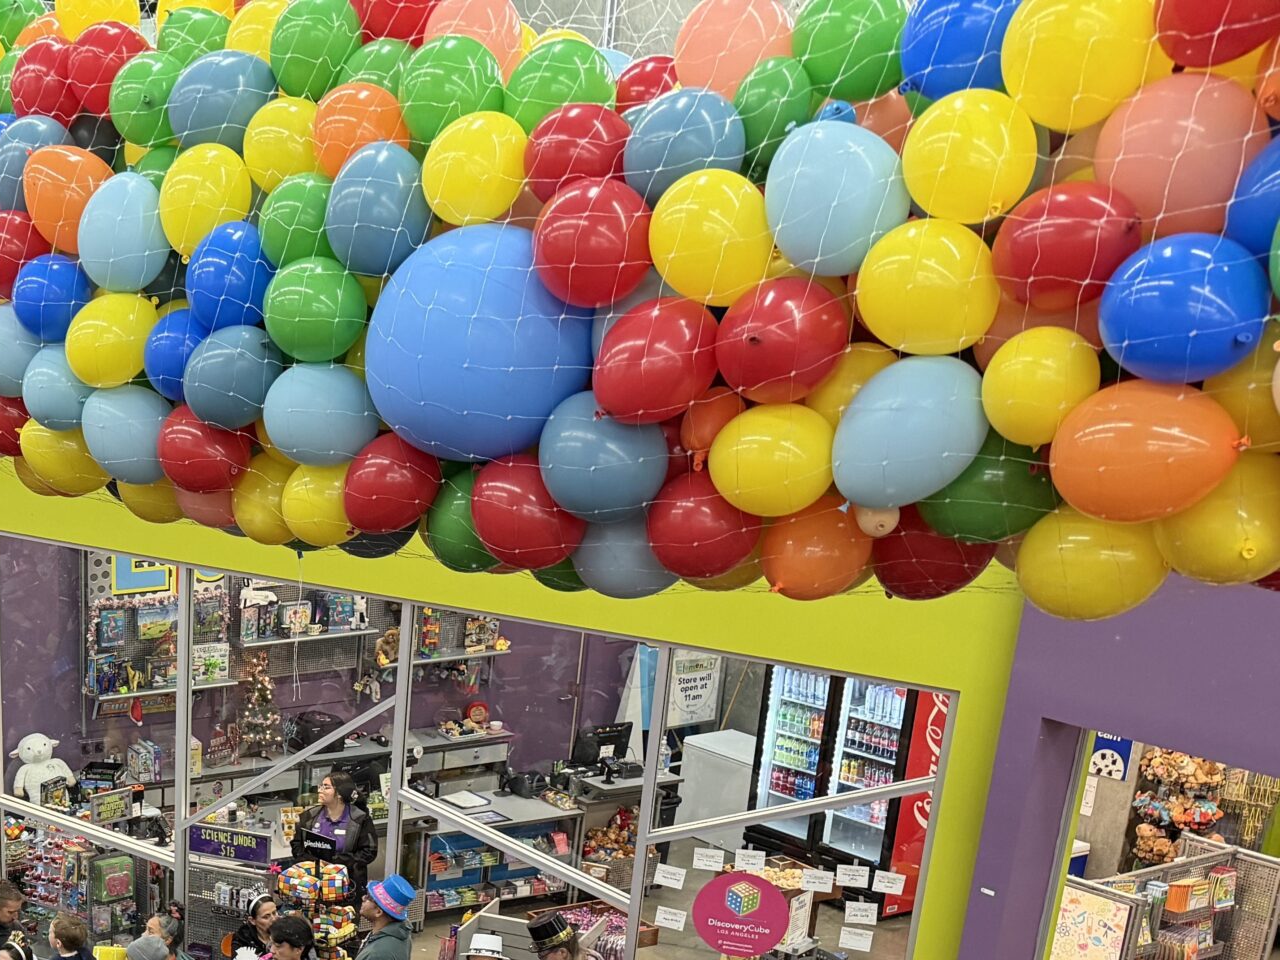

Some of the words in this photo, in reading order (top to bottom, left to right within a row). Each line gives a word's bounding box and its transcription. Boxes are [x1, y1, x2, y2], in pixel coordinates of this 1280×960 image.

[678, 676, 697, 685] Store
[700, 672, 711, 682] will
[680, 684, 698, 693] open
[201, 828, 231, 844] SCIENCE
[233, 834, 257, 849] UNDER
[220, 844, 235, 858] $15
[708, 918, 770, 934] DiscoveryCube
[731, 931, 759, 940] ANGELES
